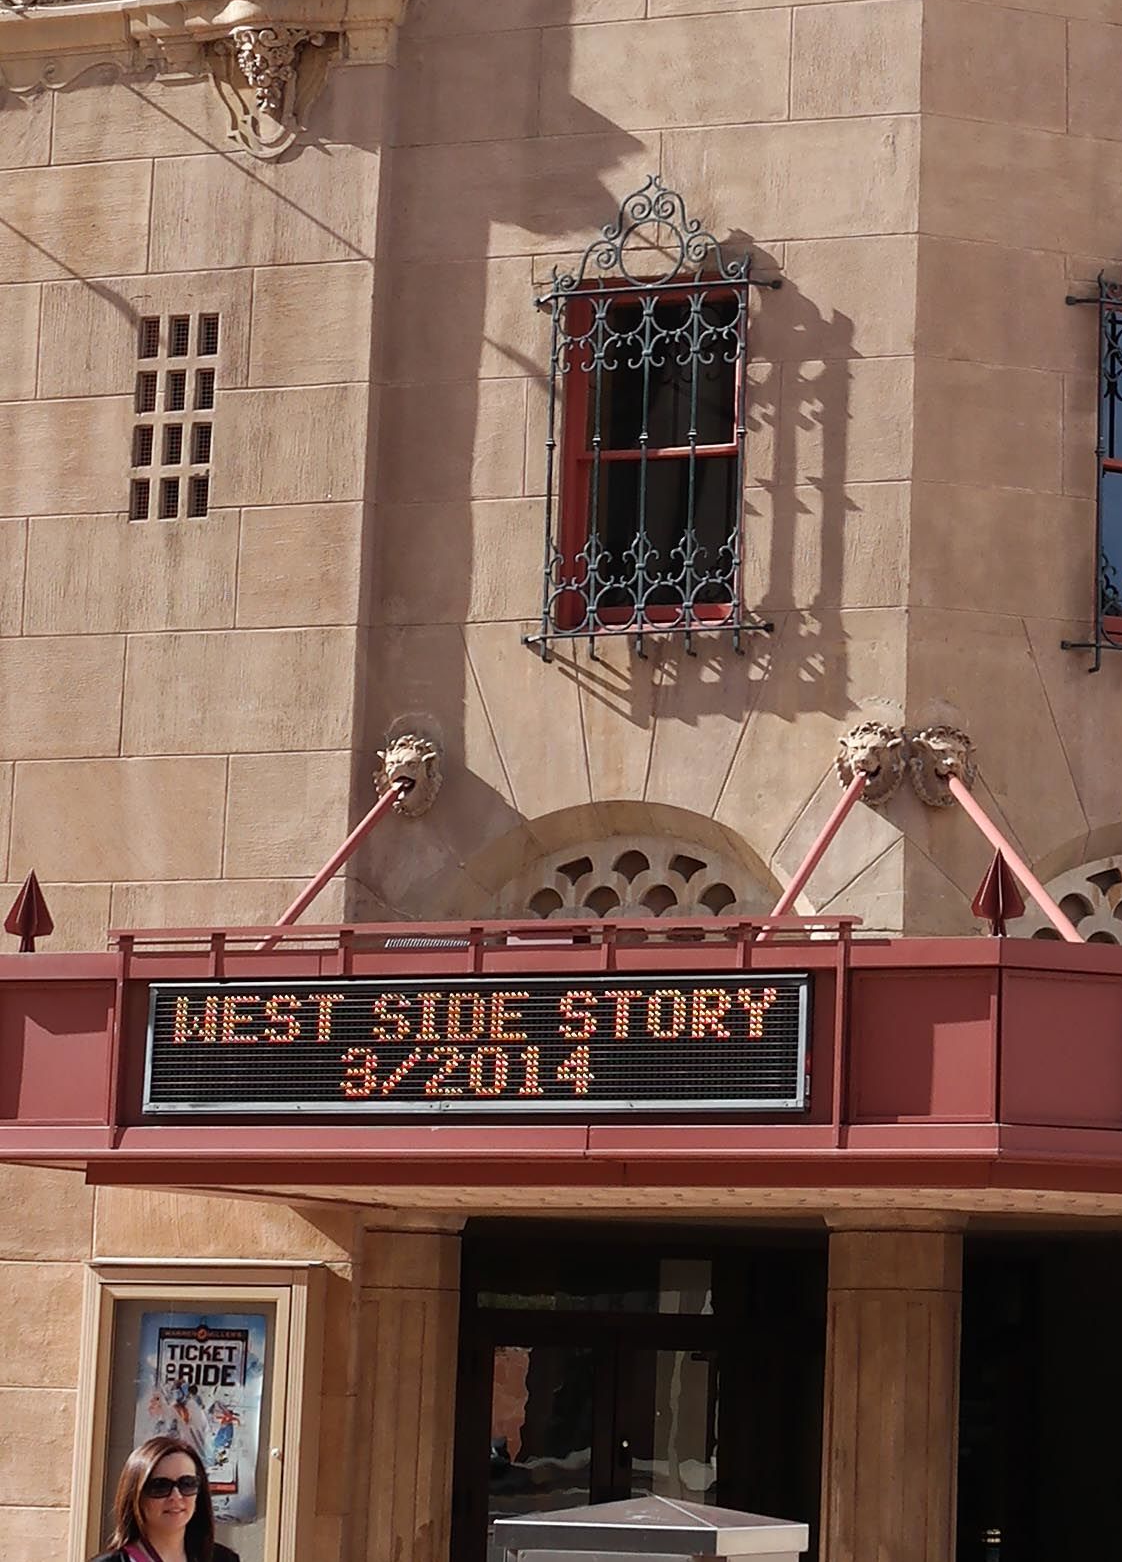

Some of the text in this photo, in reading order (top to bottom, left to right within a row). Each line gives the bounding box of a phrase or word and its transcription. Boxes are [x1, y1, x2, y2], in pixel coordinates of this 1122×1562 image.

[172, 987, 778, 1044] WEST SIDE STORY
[340, 1045, 596, 1098] 3/2014
[167, 1344, 238, 1363] TICKET
[165, 1363, 176, 1384] TO
[178, 1364, 236, 1386] RIDE
